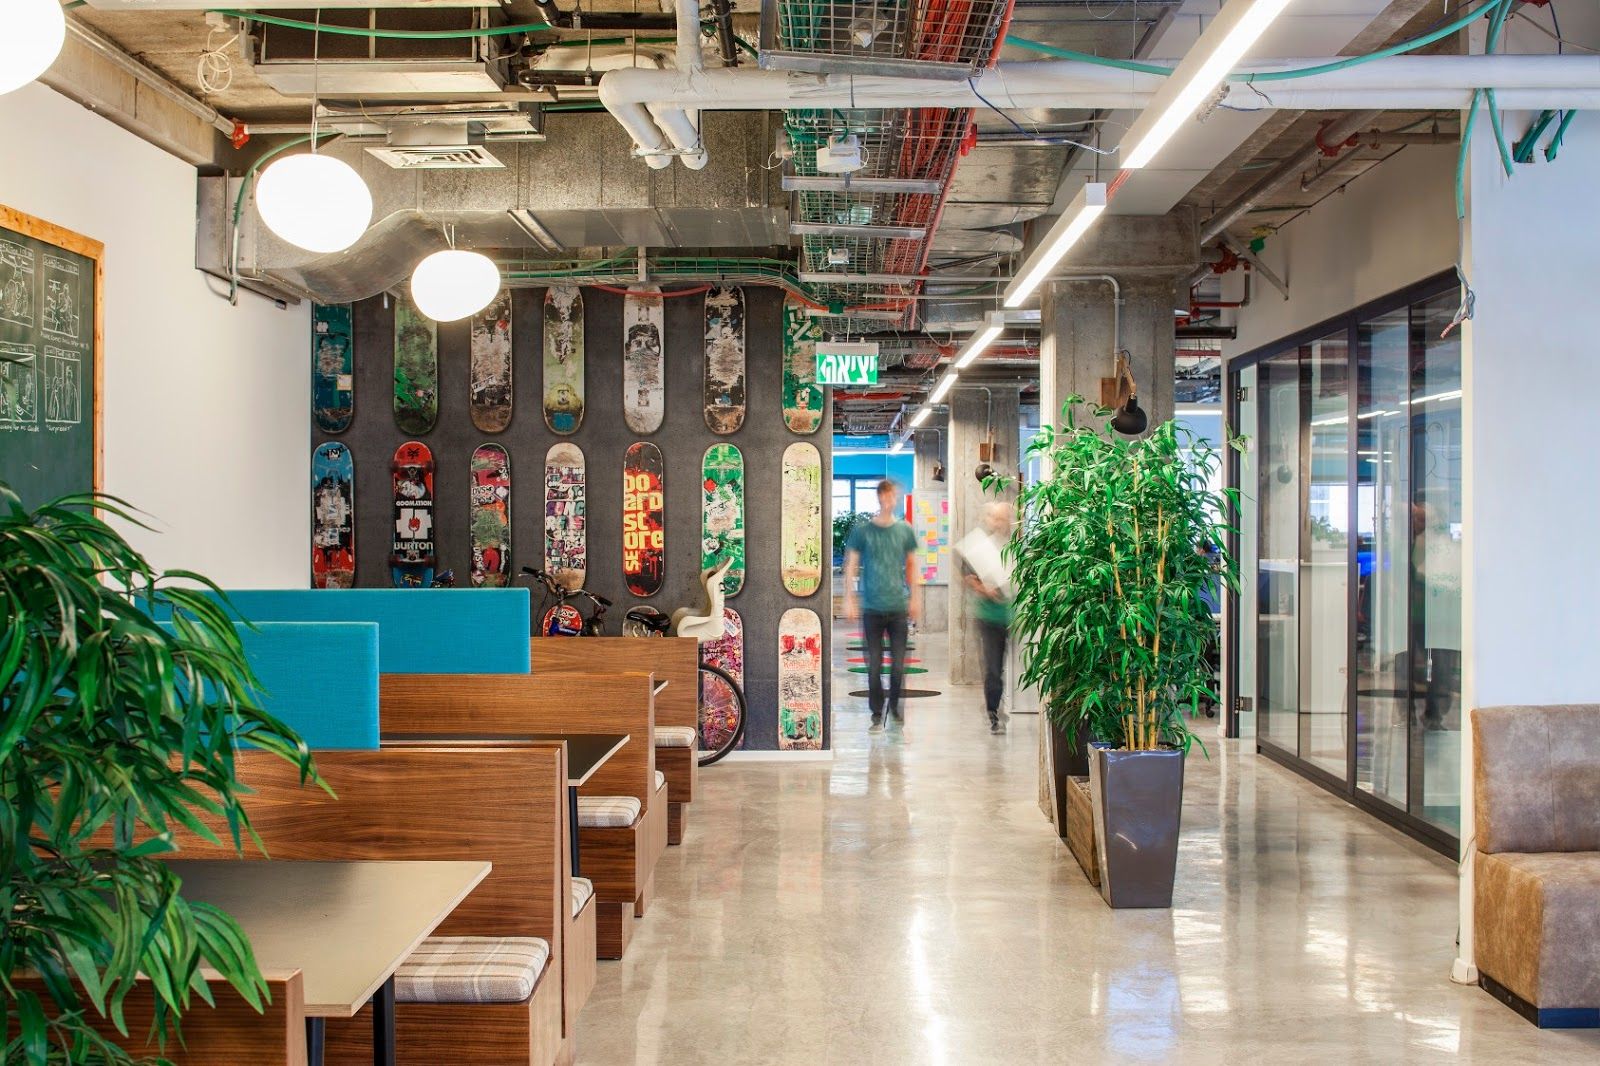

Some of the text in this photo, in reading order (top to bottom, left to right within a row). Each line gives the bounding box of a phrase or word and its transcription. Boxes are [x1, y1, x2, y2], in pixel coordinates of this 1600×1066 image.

[624, 511, 649, 531] st
[394, 541, 433, 550] BURTON
[624, 530, 664, 549] ore
